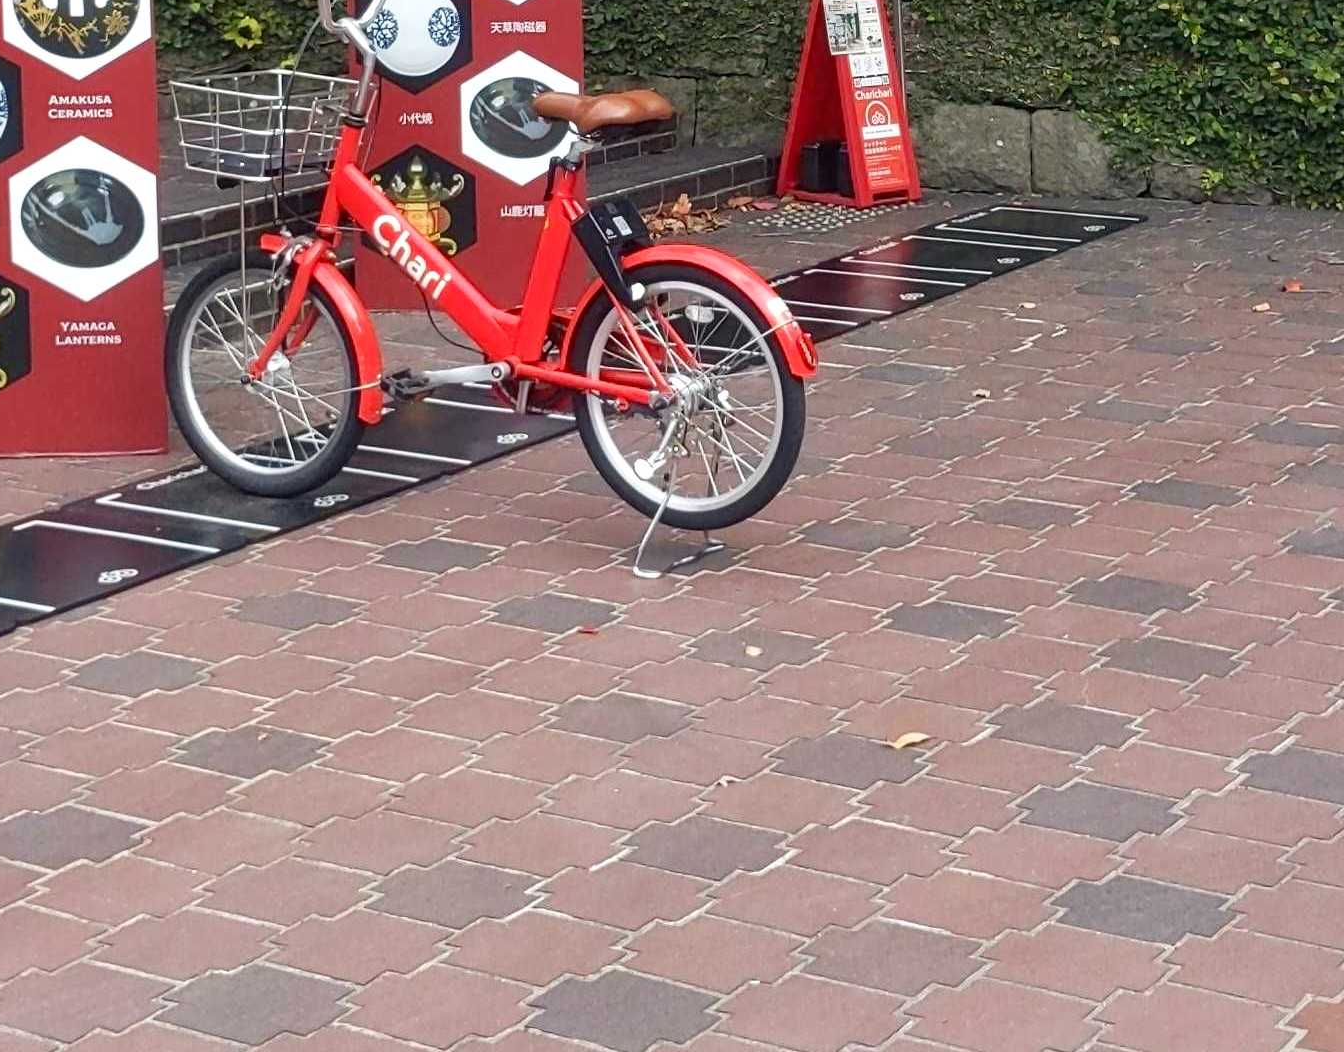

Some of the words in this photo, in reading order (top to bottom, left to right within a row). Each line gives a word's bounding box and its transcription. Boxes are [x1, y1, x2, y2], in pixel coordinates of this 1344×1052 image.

[490, 22, 547, 34] 天草陶磁器
[373, 214, 453, 300] Chari
